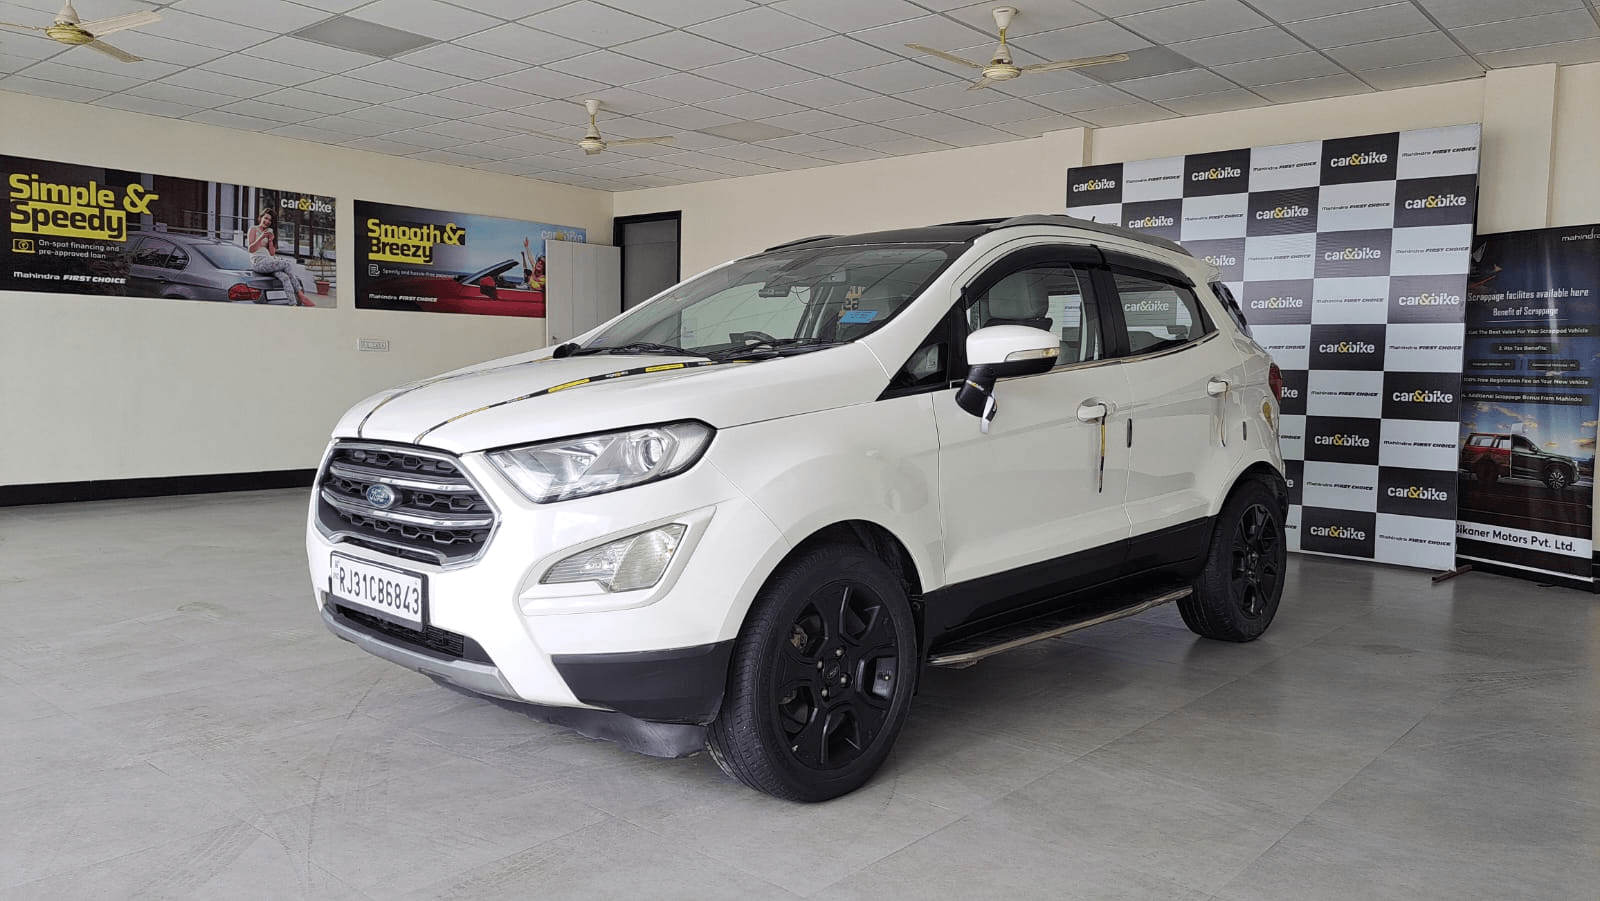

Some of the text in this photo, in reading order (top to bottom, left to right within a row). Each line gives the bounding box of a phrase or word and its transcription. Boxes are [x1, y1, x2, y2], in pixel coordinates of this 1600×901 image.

[1331, 152, 1388, 167] car&bike
[1192, 167, 1240, 181] car&bike
[1073, 179, 1115, 192] car&bike
[9, 173, 159, 214] Simple &
[281, 198, 331, 212] car&bike
[1405, 194, 1466, 209] car&bike
[10, 201, 123, 238] Speedy
[1256, 206, 1309, 220] car&bike
[1129, 216, 1173, 228] car&bike
[367, 219, 465, 245] Smooth &
[1562, 228, 1600, 240] mahindra
[39, 240, 69, 248] On-spot
[71, 241, 104, 252] financing
[369, 239, 432, 262] Breezy
[39, 249, 88, 258] pre-approved
[1325, 248, 1381, 260] car&bike
[1205, 255, 1236, 266] &bike
[14, 271, 60, 280] Mahindra
[63, 274, 91, 282] FIRST
[1399, 293, 1460, 305] car&bike
[1468, 292, 1504, 302] Scrappage
[1536, 288, 1568, 298] available
[1570, 288, 1588, 297] here
[1125, 300, 1169, 312] car&bike
[1251, 297, 1303, 309] car&bike
[1493, 307, 1558, 316] Benefit of Scrappage
[1319, 341, 1375, 354] car&bike
[1393, 390, 1453, 403] car&bike
[1315, 434, 1370, 447] car&bike
[1388, 486, 1448, 501] car&bike
[1310, 526, 1365, 540] car&bike
[1493, 530, 1527, 544] Motors
[1531, 536, 1551, 548] Pvt.
[1555, 539, 1576, 552] Ltd.
[340, 567, 419, 614] RJ31CB6843
